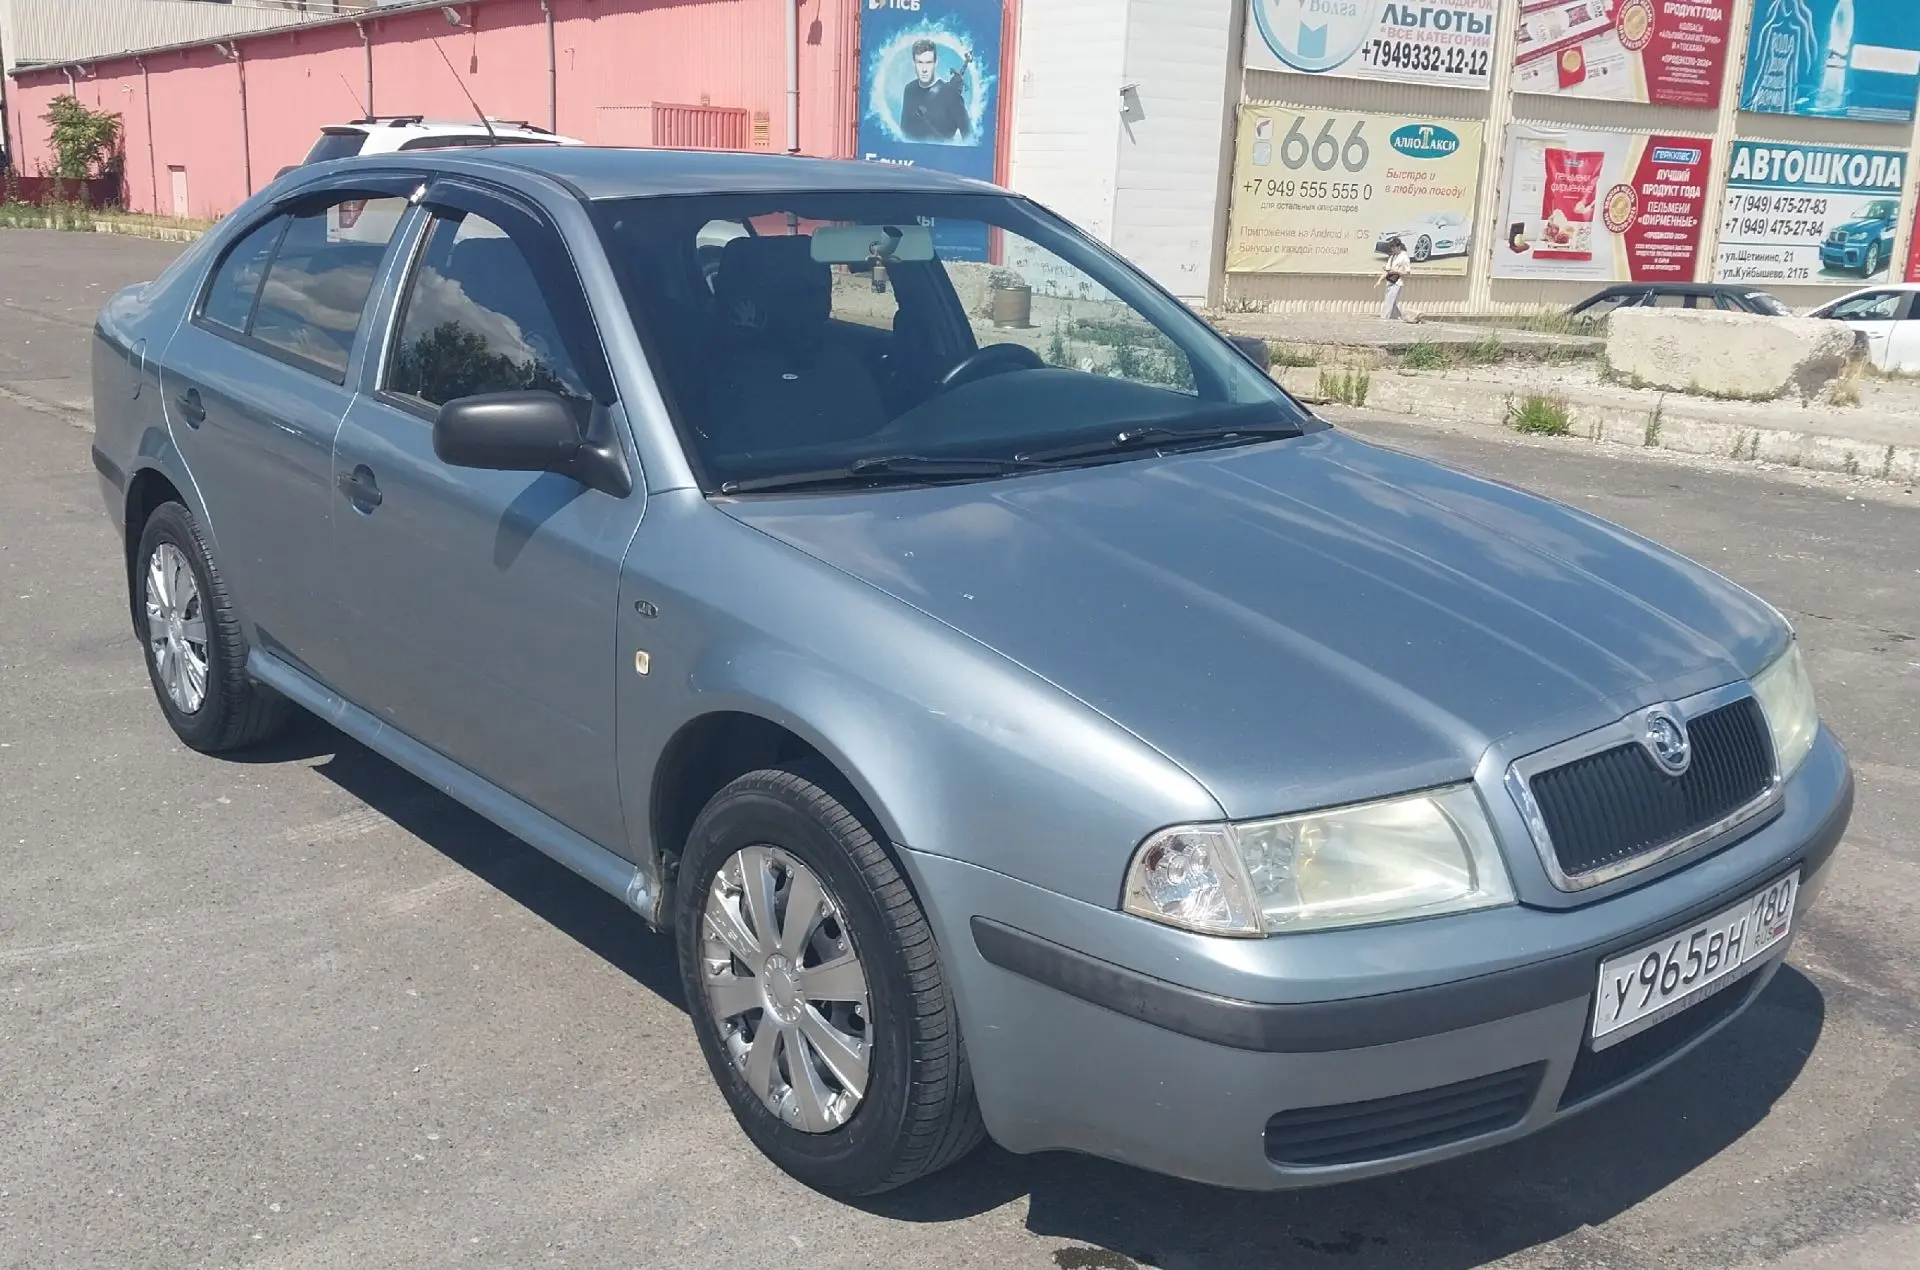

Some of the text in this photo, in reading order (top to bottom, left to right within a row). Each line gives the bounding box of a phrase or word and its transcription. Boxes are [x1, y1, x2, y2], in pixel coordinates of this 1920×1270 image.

[1663, 1, 1701, 18] ПРОДУКТ
[1380, 4, 1493, 35] ЛЬГОТЫ
[1416, 31, 1490, 47] КАТЕГОРИИ
[1361, 40, 1488, 76] +7949332-12-12
[1280, 116, 1370, 172] 666
[1386, 167, 1427, 182] Быстро
[1656, 168, 1691, 182] ЛУЧШИЙ
[1731, 147, 1901, 188] АВТОШКОЛА
[1243, 178, 1372, 201] +7 949 555 555 0
[1393, 184, 1428, 196] любую
[1429, 186, 1467, 198] погоду!
[1642, 183, 1701, 199] ПРОДУКТ ГОДА
[1260, 202, 1276, 211] для
[1276, 202, 1315, 212] остальных
[1647, 201, 1691, 214] ПЕЛЬМЕНИ
[1728, 195, 1827, 215] +7 (949) 475-27-83
[1240, 225, 1296, 239] Приложение
[1725, 217, 1824, 238] +7 (949) 475-27-84
[1239, 243, 1273, 256] Бонусы
[1783, 252, 1794, 263] 21
[1752, 879, 1792, 933] 180
[1754, 926, 1774, 948] RUS
